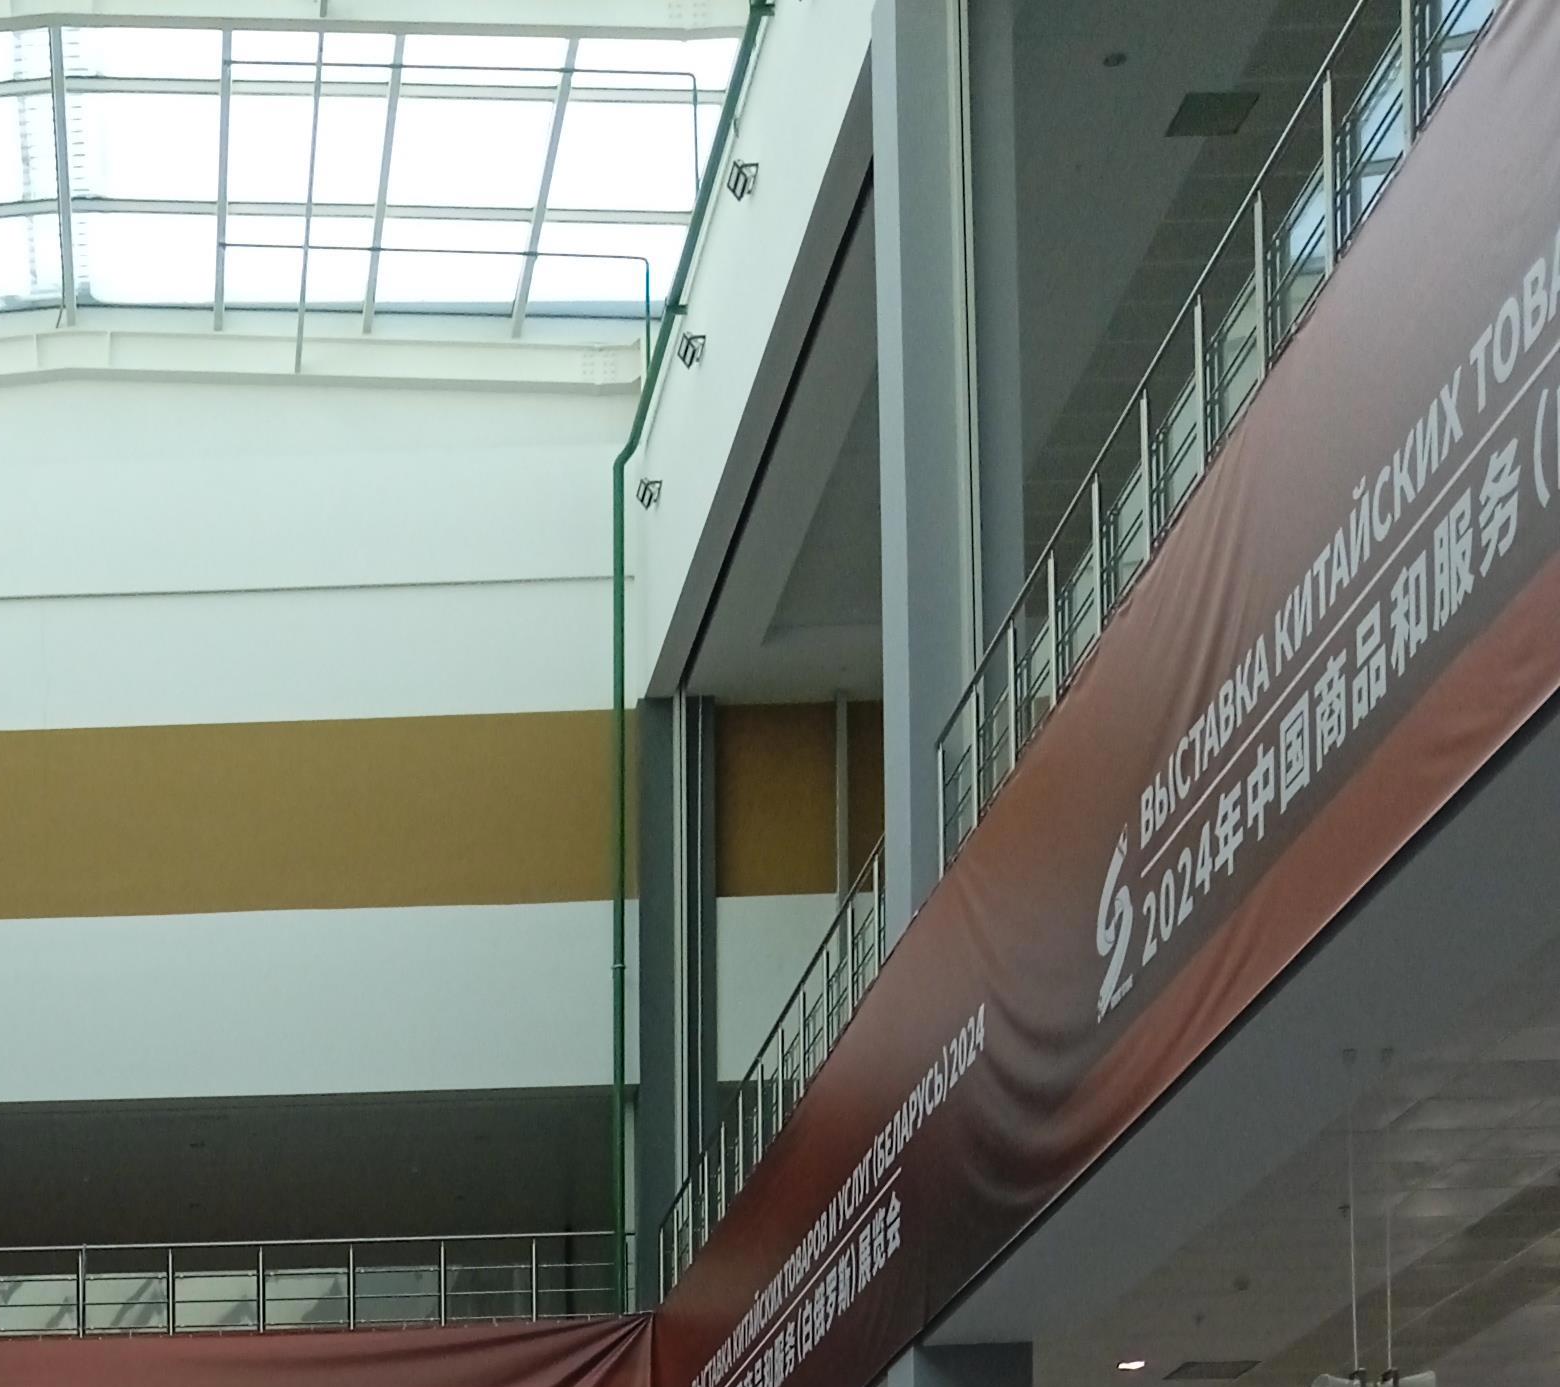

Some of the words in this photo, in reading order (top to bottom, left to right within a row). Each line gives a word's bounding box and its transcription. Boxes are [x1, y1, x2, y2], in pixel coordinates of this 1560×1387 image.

[1140, 635, 1270, 850] ВЫСТАВКА
[1275, 365, 1464, 677] КИТАЙСКИХ
[1142, 388, 1560, 967] 2024年中国商品和服务（
[732, 1268, 782, 1363] КИТАЙСКИХ
[783, 1211, 827, 1298] ТОВАРОВ
[828, 1196, 837, 1238] И
[838, 1148, 873, 1231] УСЛУГ
[872, 1045, 949, 1187] (БЕЛАРУСЬ)
[949, 1002, 985, 1089] 2024
